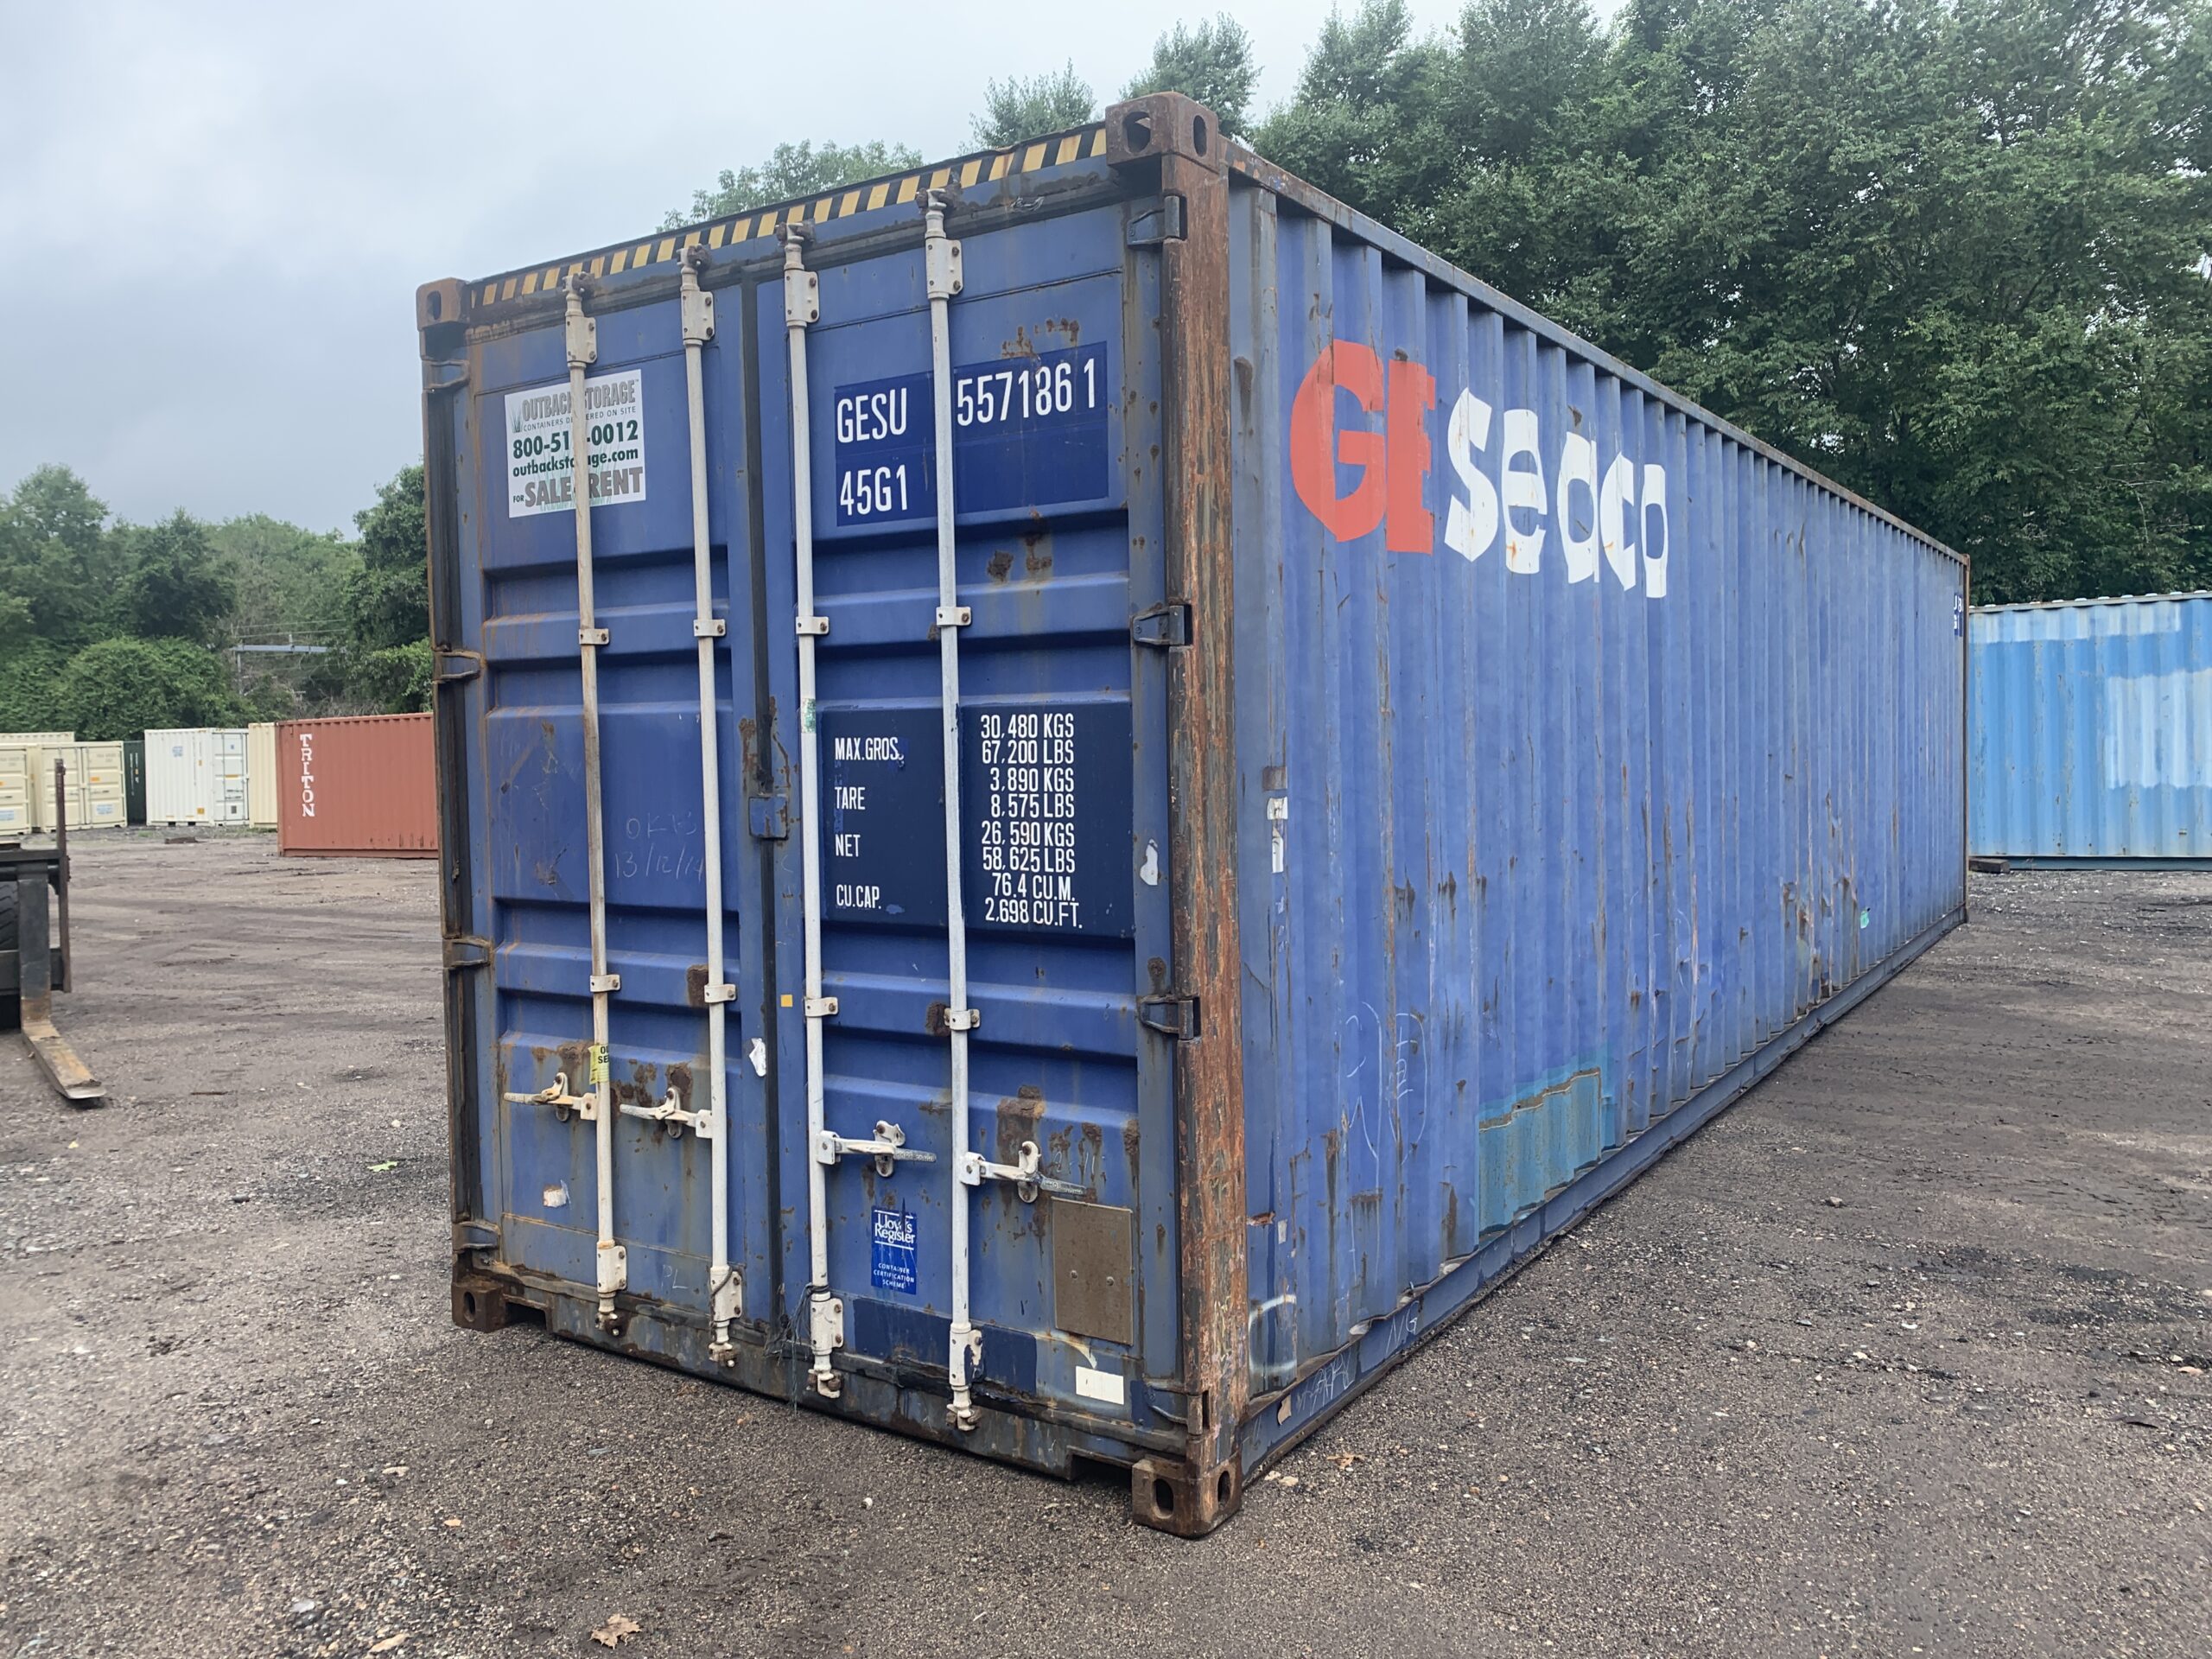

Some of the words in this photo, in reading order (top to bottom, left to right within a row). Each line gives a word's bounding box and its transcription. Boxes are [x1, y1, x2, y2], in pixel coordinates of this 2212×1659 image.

[584, 380, 635, 410] TORAGE
[836, 388, 907, 443] GESU
[957, 362, 1071, 426] 557186
[524, 418, 563, 432] CONTAINERS
[566, 411, 604, 423] DERED
[607, 409, 618, 417] ON
[513, 420, 638, 459] 800-51-0012
[513, 448, 638, 477] outbackstoge.com
[524, 476, 571, 507] SALE
[588, 467, 643, 499] RENT
[840, 464, 907, 516] 45G1
[1044, 713, 1074, 738] KGS
[1044, 739, 1074, 764] LBS
[300, 734, 315, 817] TRITON
[1044, 767, 1074, 792] KGS
[835, 786, 866, 810] TARE
[1044, 792, 1075, 817] LBS
[836, 834, 861, 857] NET
[1044, 822, 1075, 847] KGS
[1045, 848, 1076, 873] LBS
[836, 885, 881, 909] CU.CAP.
[992, 872, 1027, 898] 76.4
[1033, 874, 1075, 901] CU.M.
[985, 897, 1029, 924] 2,698
[874, 1223, 916, 1244] Register
[874, 1269, 914, 1283] CERTIFICATION
[878, 1262, 910, 1274] CONTAINER
[882, 1279, 905, 1289] SCHEME
